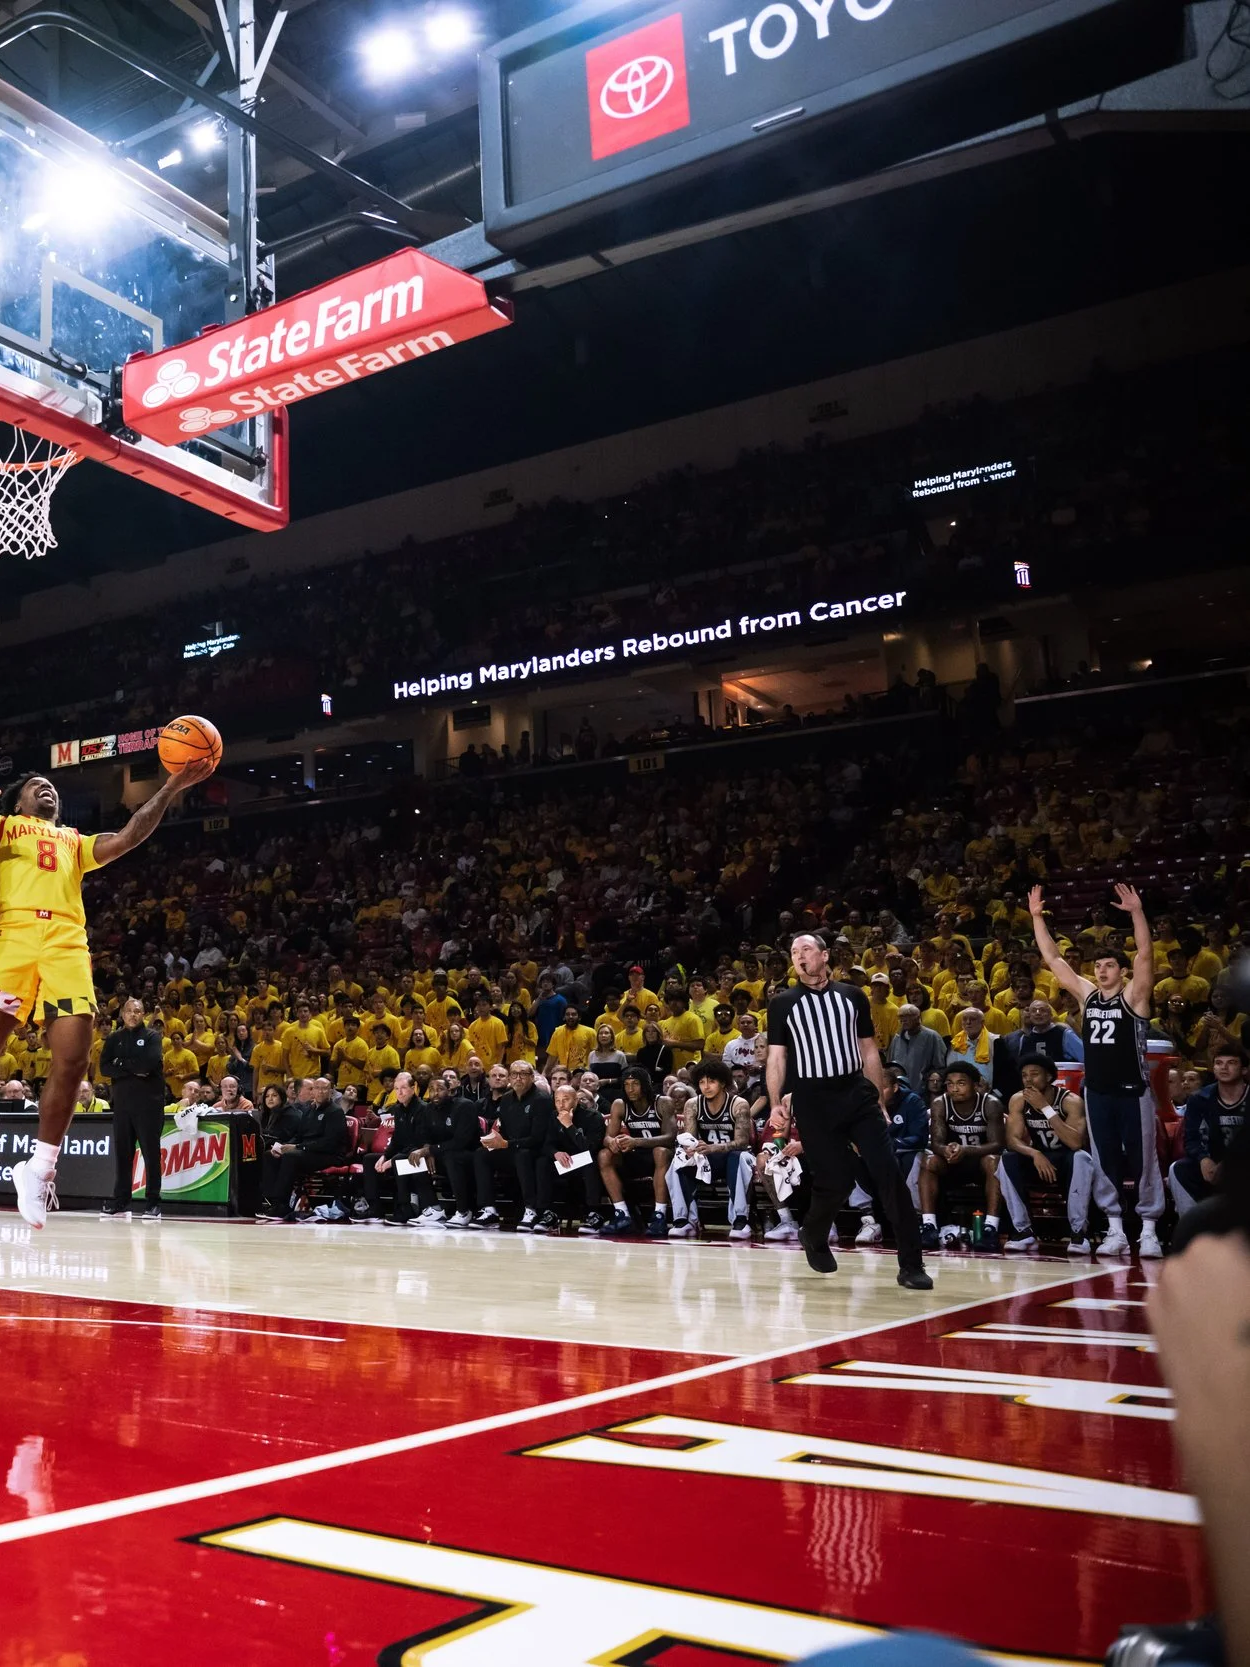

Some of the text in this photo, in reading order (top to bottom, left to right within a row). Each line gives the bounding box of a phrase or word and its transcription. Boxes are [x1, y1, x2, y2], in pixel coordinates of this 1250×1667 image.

[912, 482, 955, 498] Rebound
[956, 477, 980, 489] from
[914, 474, 951, 489] Helping
[393, 589, 908, 701] Helping Marylanders Rebound from Cancer
[57, 742, 72, 763] M
[118, 739, 159, 755] TERRAP
[37, 840, 57, 872] 8
[1086, 1008, 1122, 1019] GEORGETOWN
[1090, 1020, 1115, 1044] 22
[1027, 1119, 1051, 1128] GEORGET
[13, 1135, 110, 1156] Maland
[242, 1134, 256, 1158] M
[707, 1130, 730, 1145] 45
[959, 1134, 980, 1146] 13
[1037, 1130, 1062, 1149] 12
